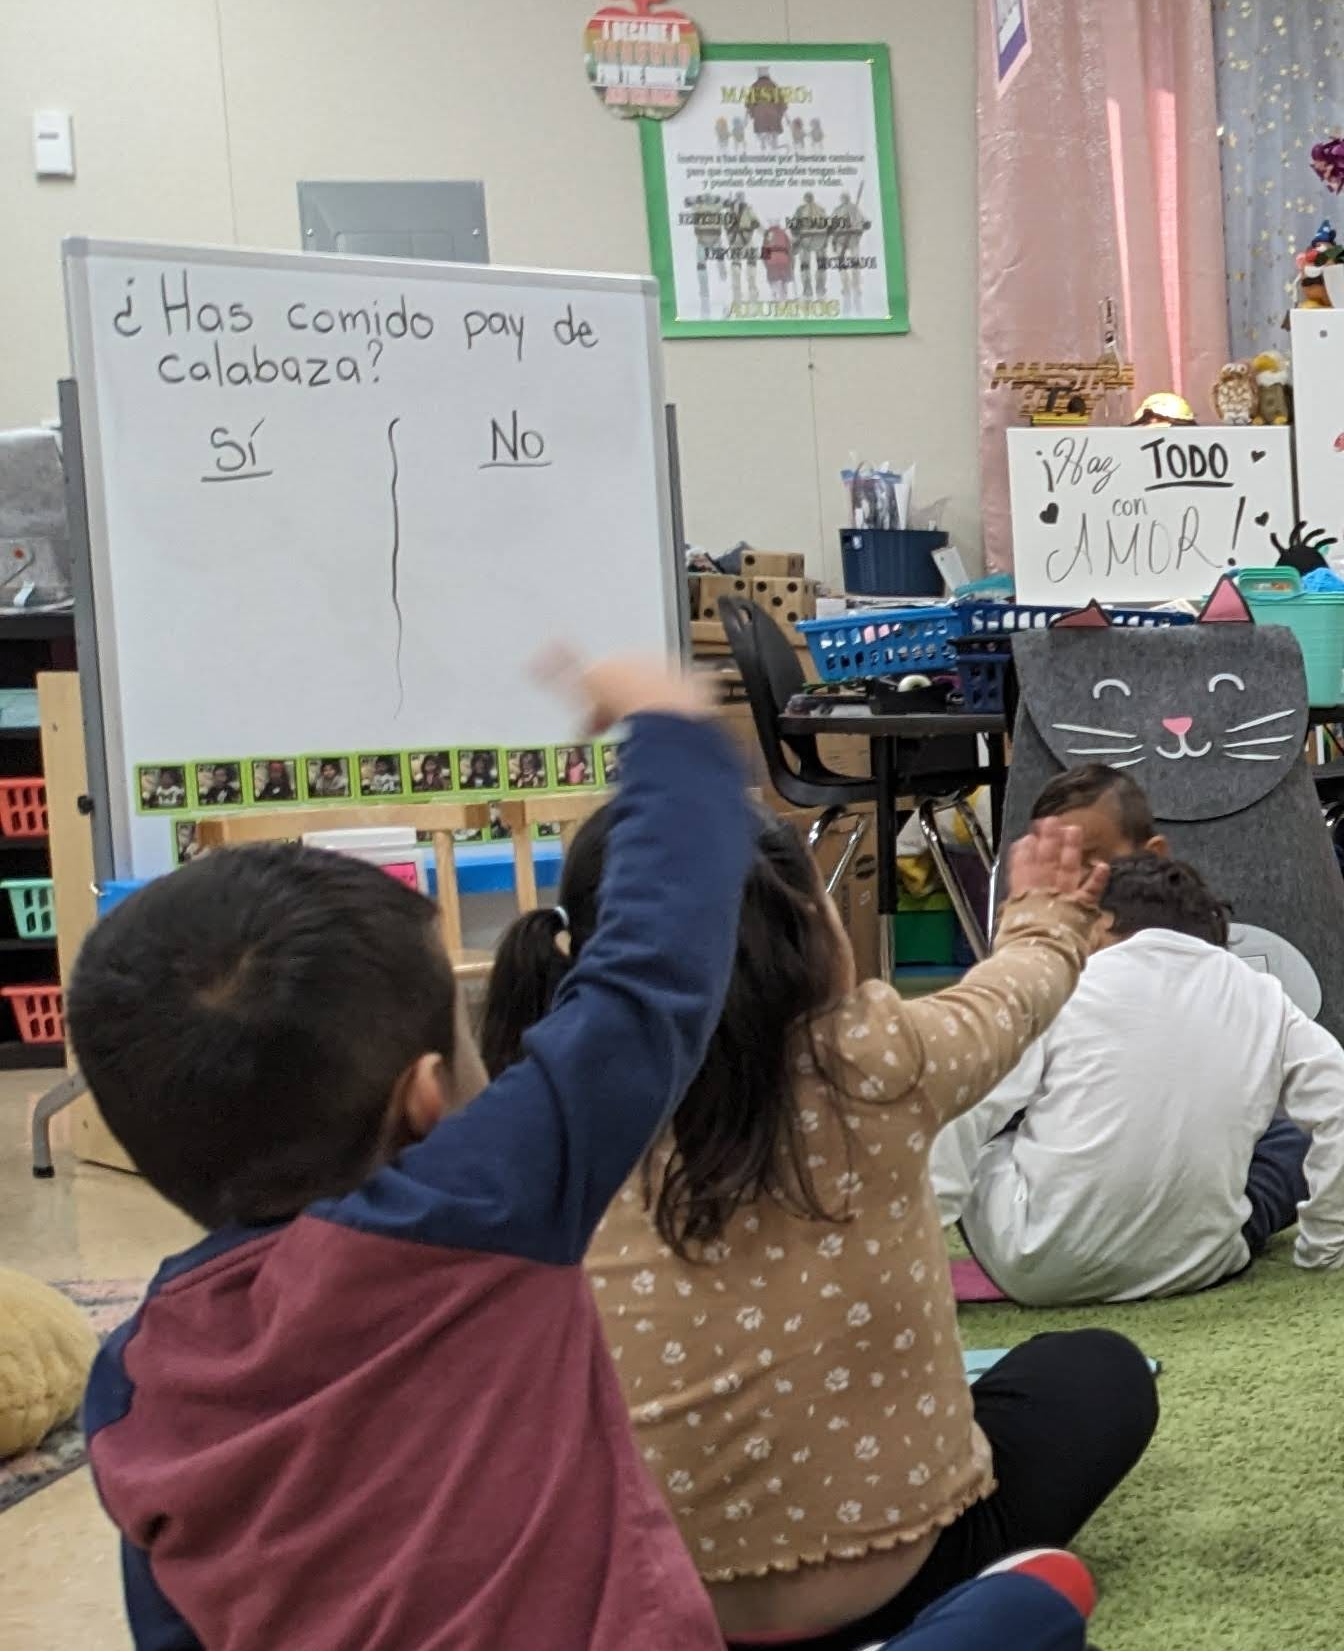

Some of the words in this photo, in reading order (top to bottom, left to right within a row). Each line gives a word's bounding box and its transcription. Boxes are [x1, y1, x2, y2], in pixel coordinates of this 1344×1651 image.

[113, 270, 254, 337] ¿Has
[287, 296, 434, 343] comido
[464, 311, 525, 362] pay
[553, 304, 599, 349] de
[157, 340, 386, 387] calabaza?
[209, 418, 266, 472] Sí
[490, 409, 545, 462] No
[1140, 437, 1230, 481] TODO
[1111, 497, 1148, 519] con
